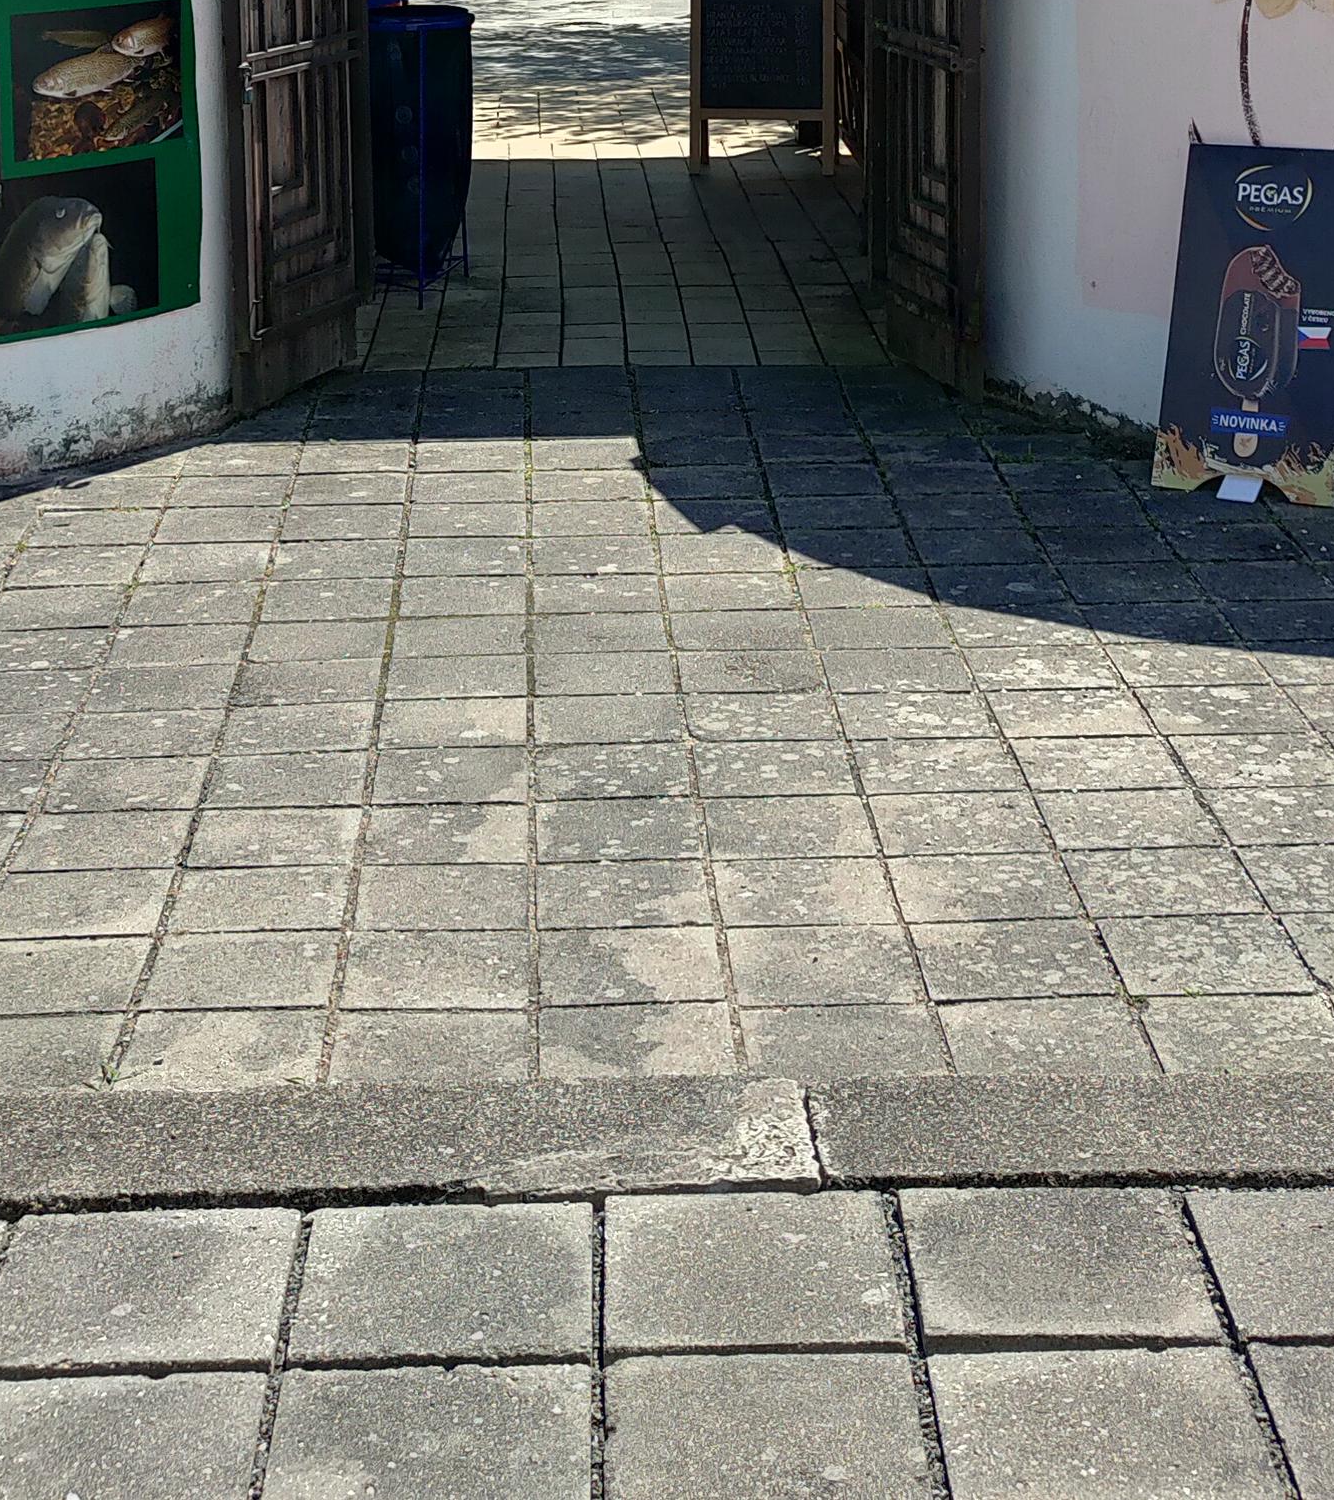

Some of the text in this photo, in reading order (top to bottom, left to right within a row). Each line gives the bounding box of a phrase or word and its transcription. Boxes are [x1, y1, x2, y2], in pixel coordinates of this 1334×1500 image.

[1237, 182, 1304, 206] PEGAS
[1235, 340, 1251, 380] PEGAS
[1219, 414, 1278, 432] NOVINKA
